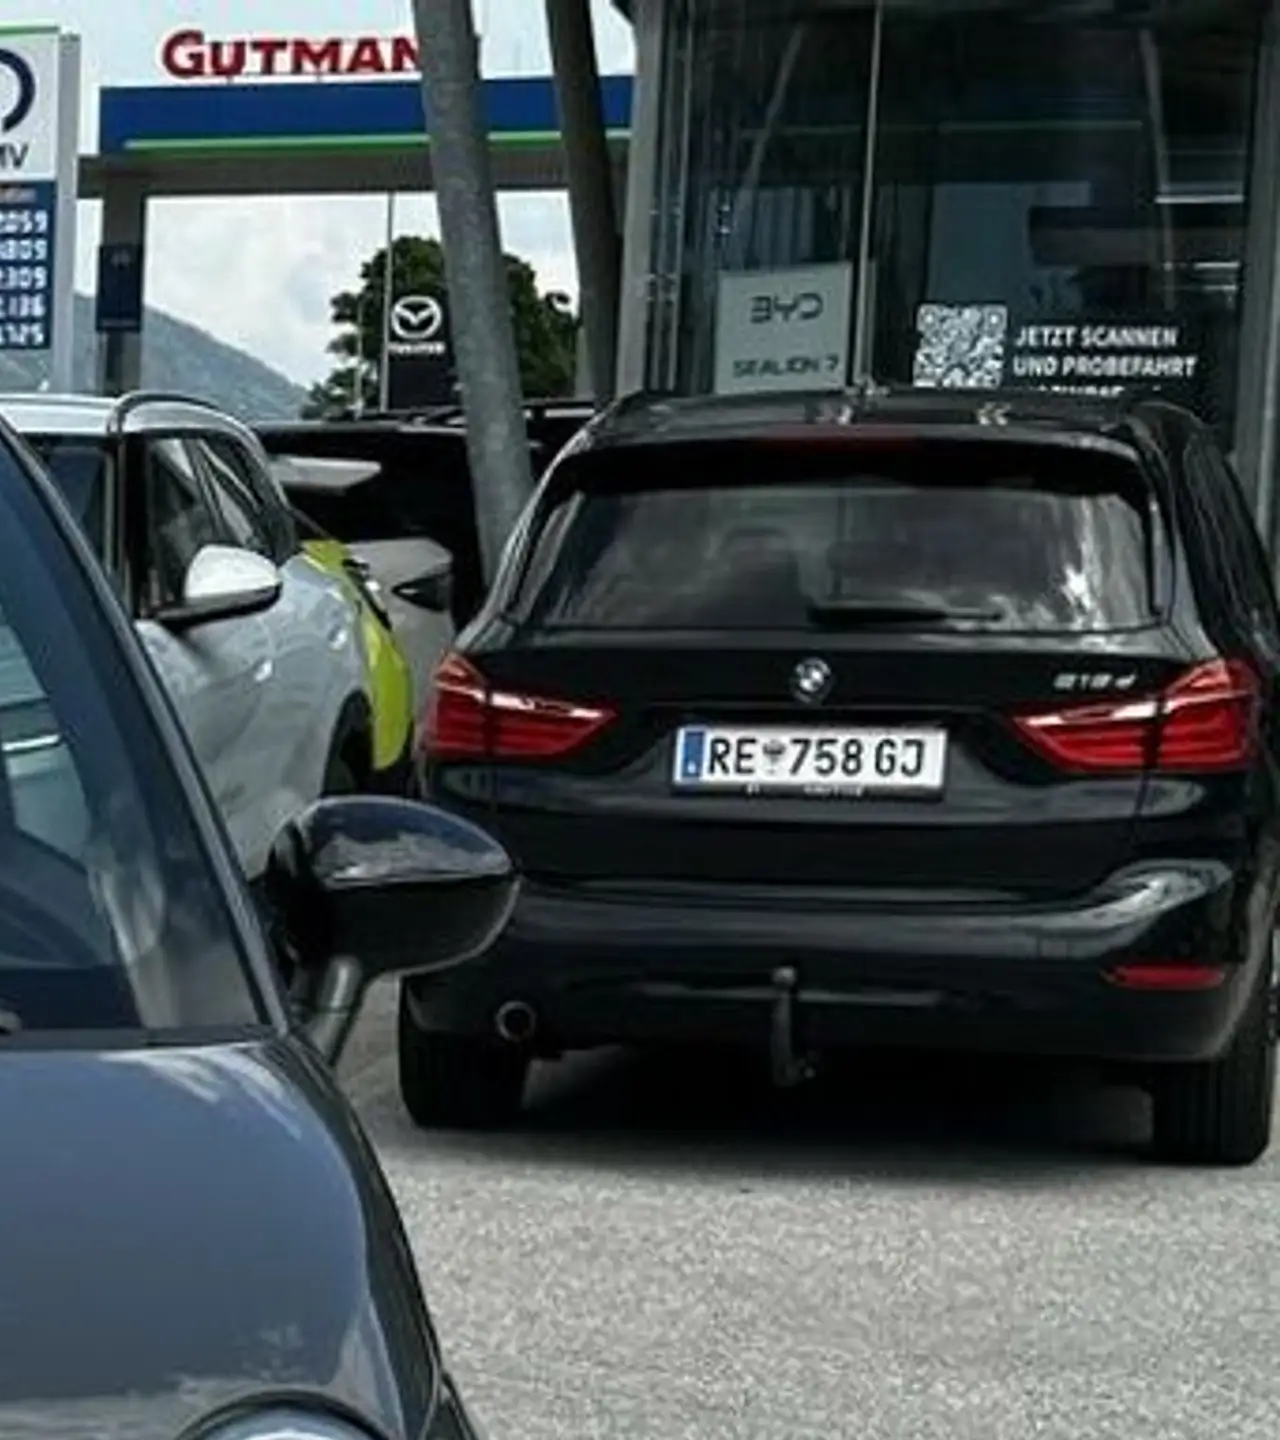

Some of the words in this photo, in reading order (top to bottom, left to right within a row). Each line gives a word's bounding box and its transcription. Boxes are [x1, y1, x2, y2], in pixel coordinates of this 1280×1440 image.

[1015, 325, 1077, 348] JETZT
[1081, 325, 1178, 348] SCANNEN
[1013, 356, 1058, 377] UND
[1062, 356, 1197, 377] PROBEFAHRT
[709, 737, 758, 775] RE
[789, 738, 864, 777] 758
[874, 738, 925, 777] GJ
